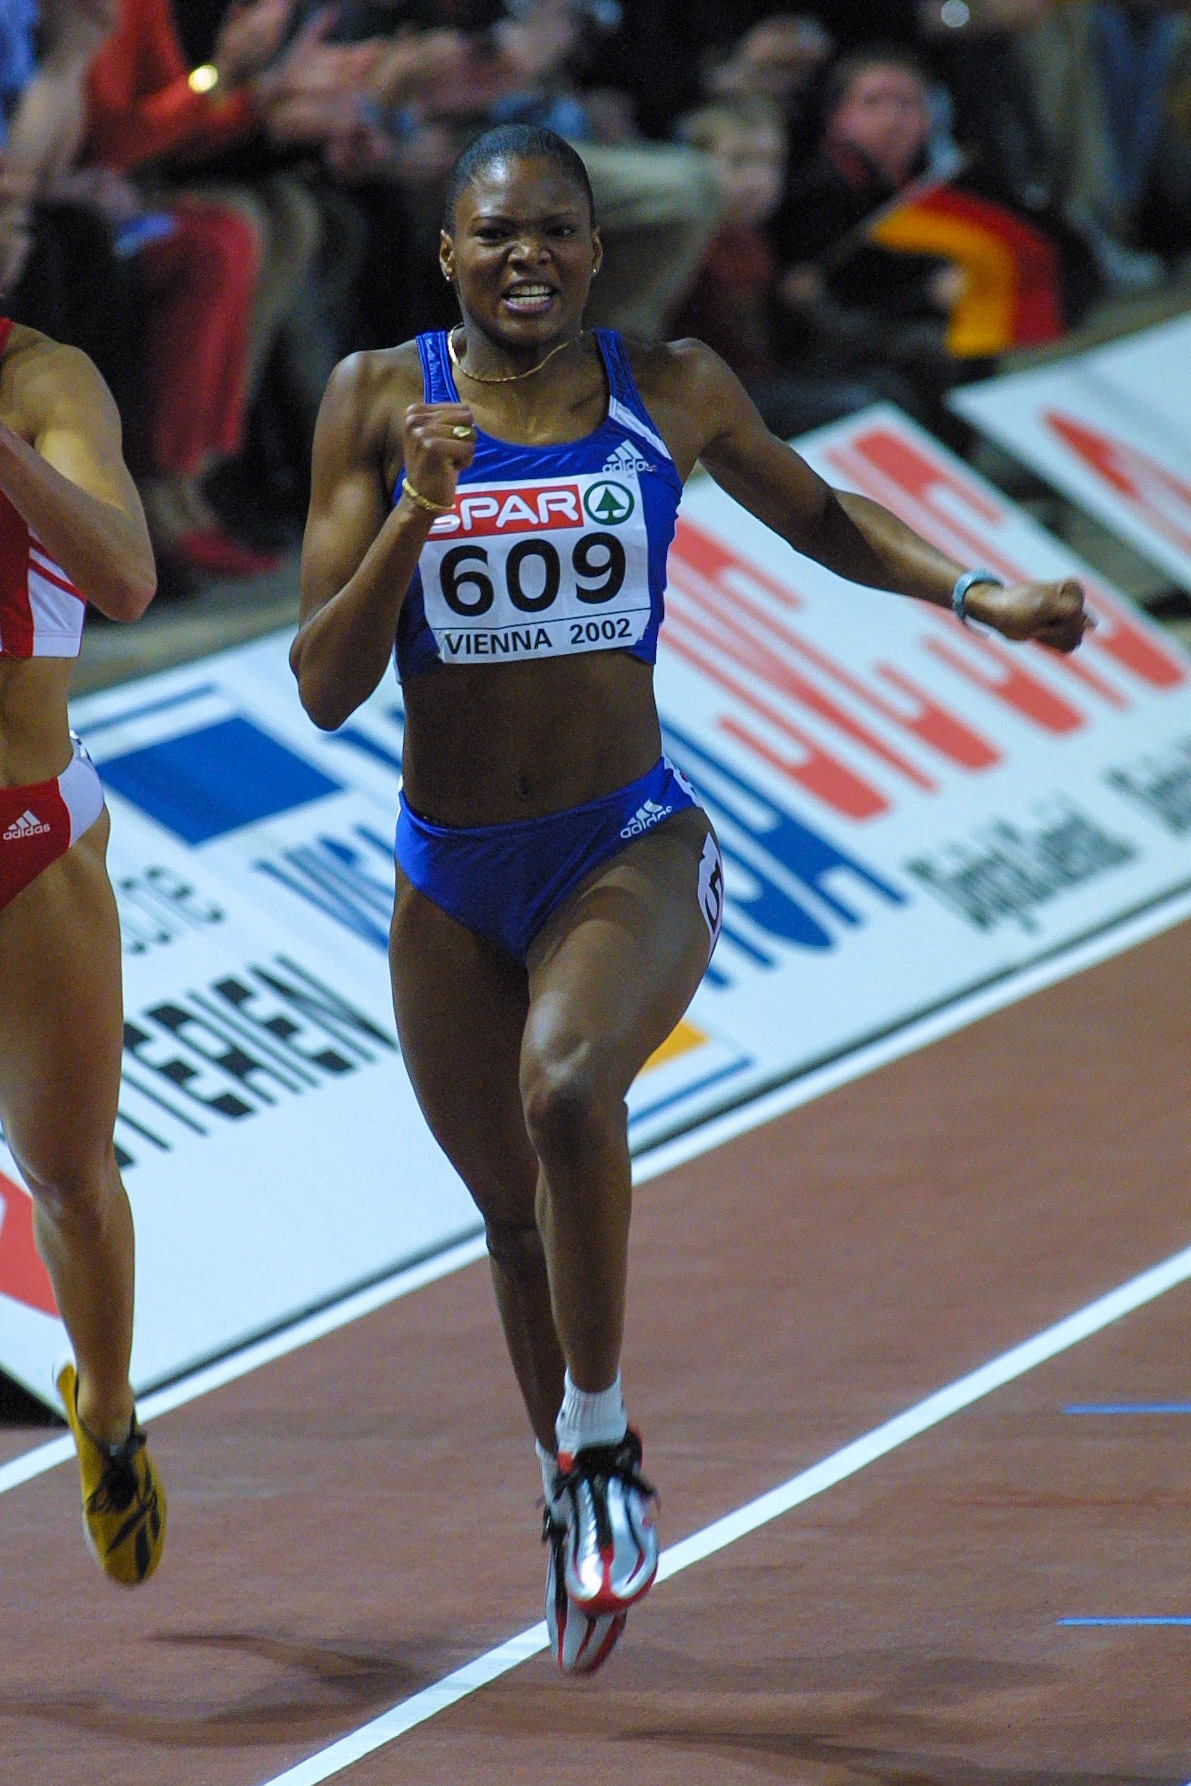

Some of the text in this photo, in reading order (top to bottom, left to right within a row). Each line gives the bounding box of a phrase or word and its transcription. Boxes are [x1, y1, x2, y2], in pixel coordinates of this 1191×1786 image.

[438, 532, 626, 617] 609
[445, 618, 632, 656] VIENNA 2002
[2, 823, 51, 840] adidas
